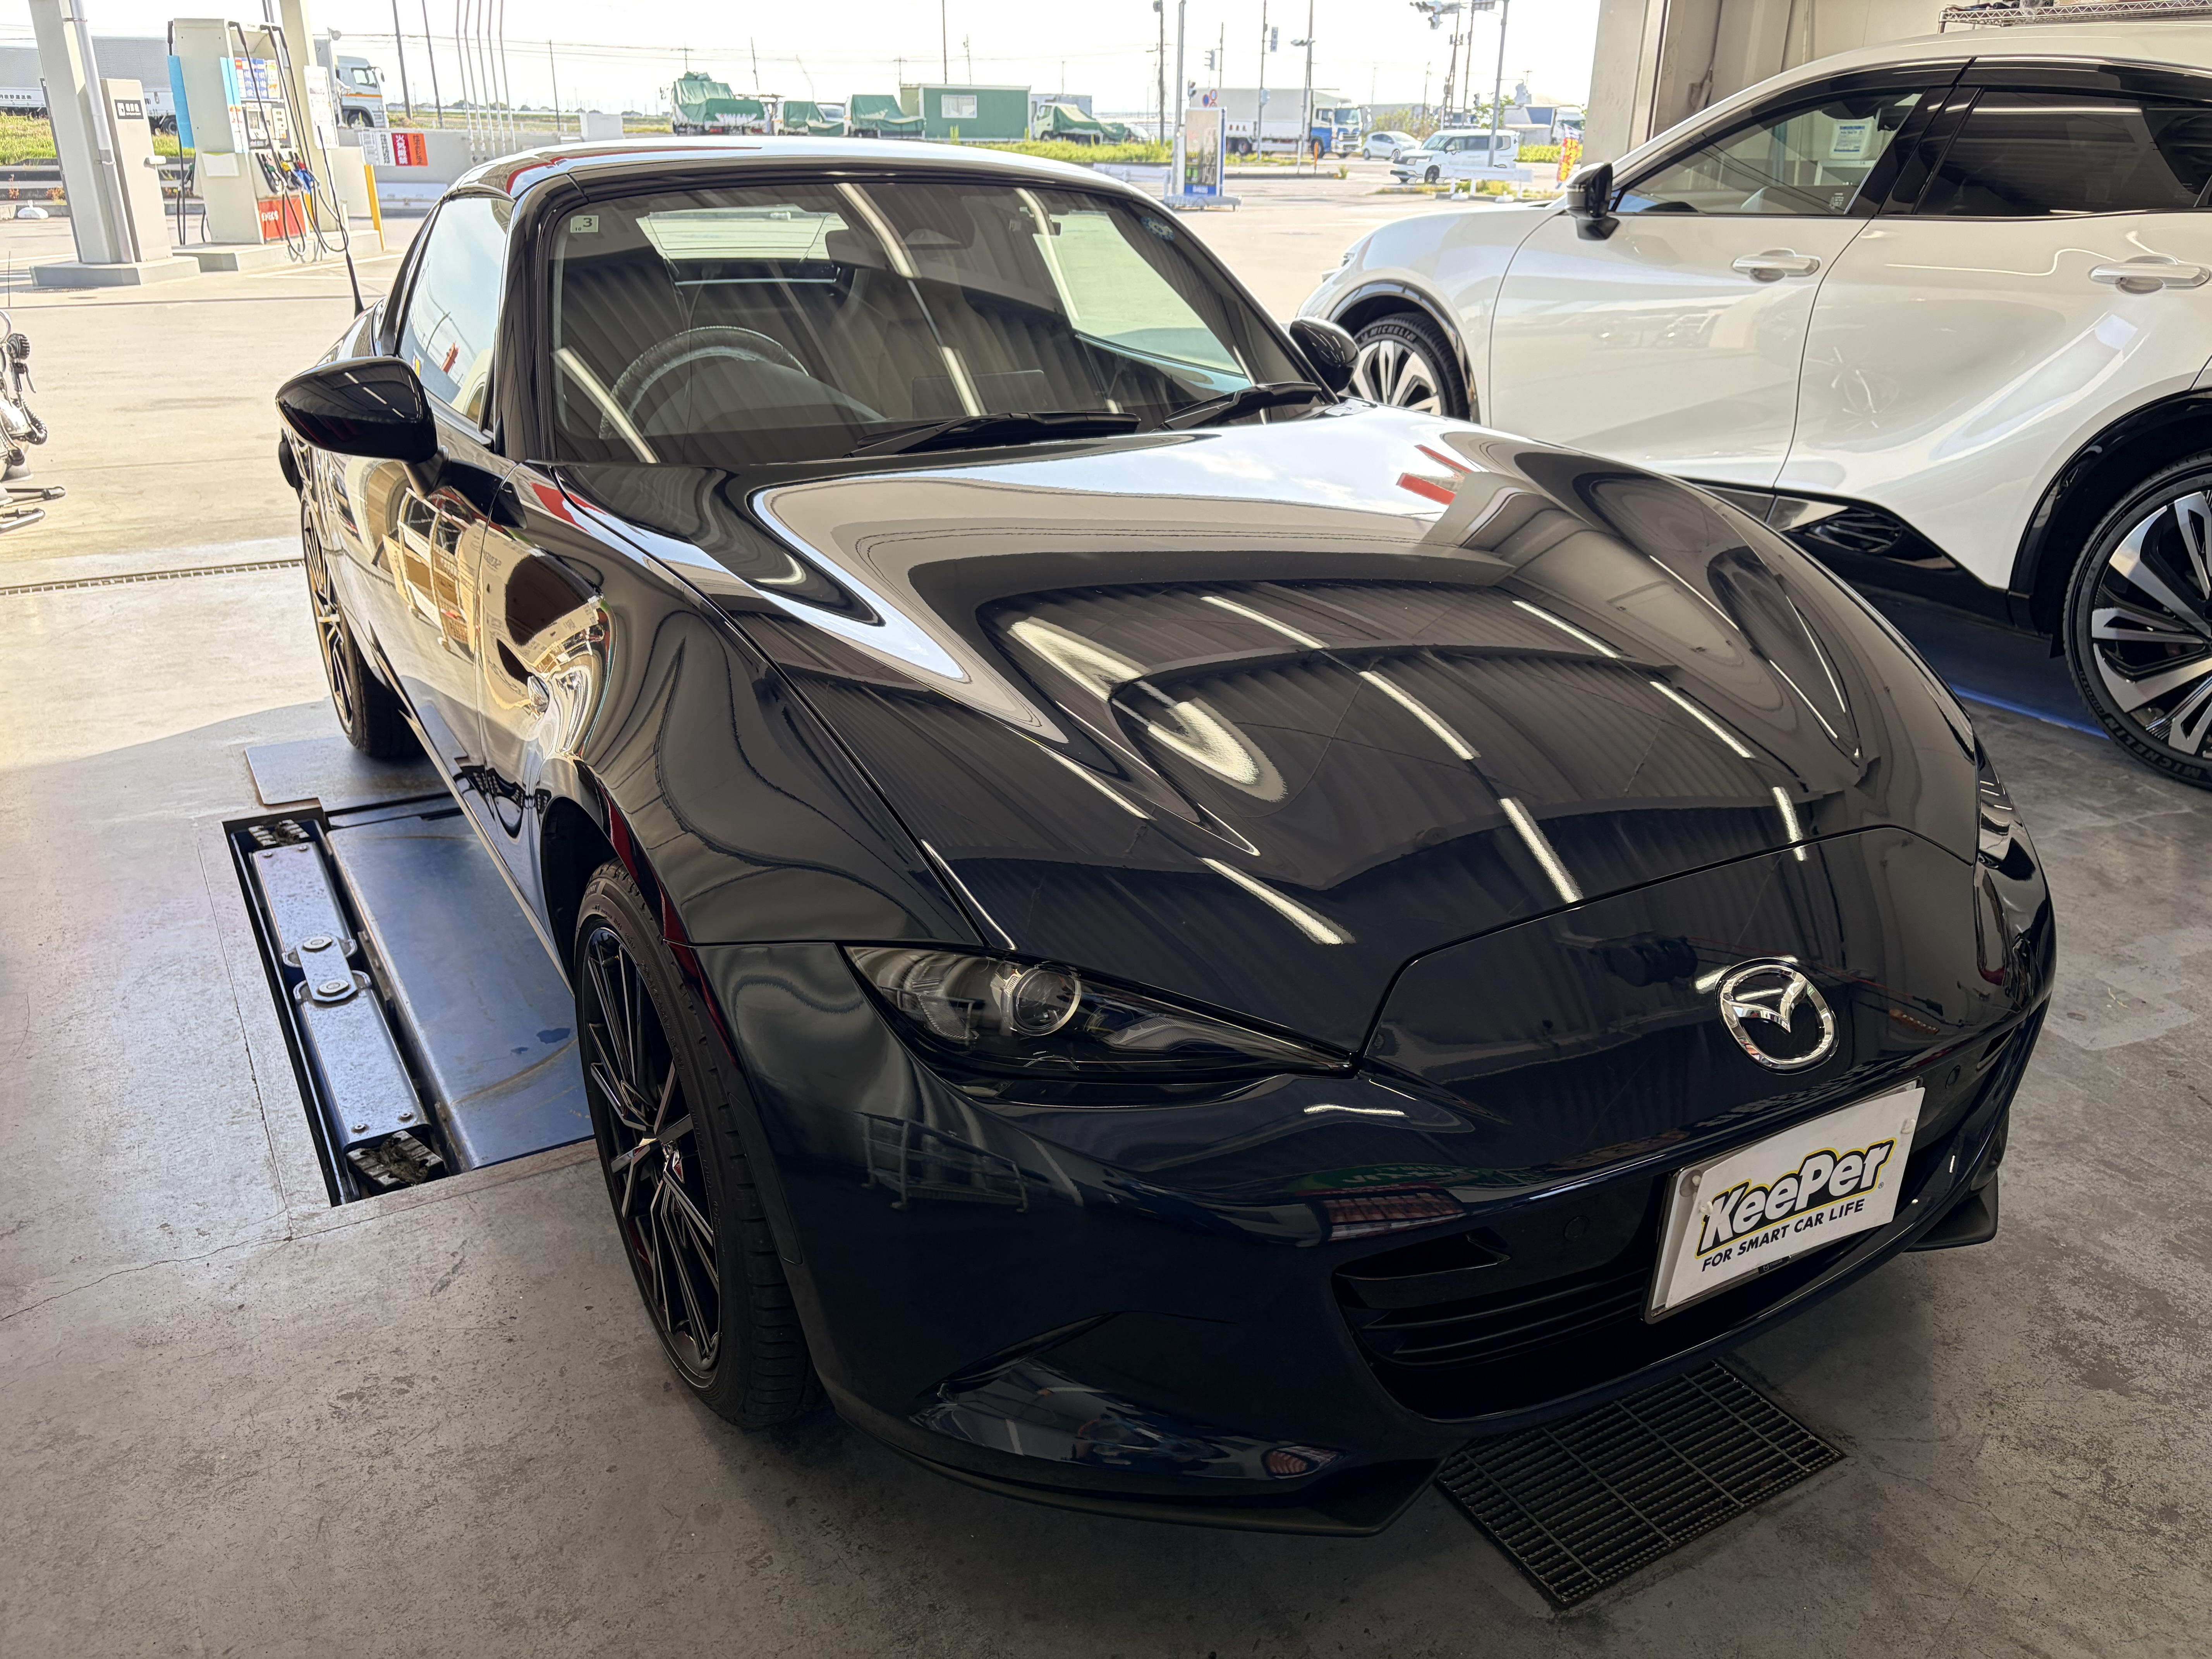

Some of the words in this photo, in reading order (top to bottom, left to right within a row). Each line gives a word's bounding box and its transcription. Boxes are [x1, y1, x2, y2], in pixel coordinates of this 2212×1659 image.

[583, 218, 592, 227] 3
[1369, 325, 1417, 342] MICHELIN
[2104, 717, 2202, 777] MICHELIN
[1696, 1140, 1894, 1257] KeePer
[1702, 1248, 1733, 1272] FOR
[1737, 1224, 1790, 1256] SMART
[1794, 1212, 1824, 1233] CAR
[1829, 1198, 1865, 1221] LIFE
